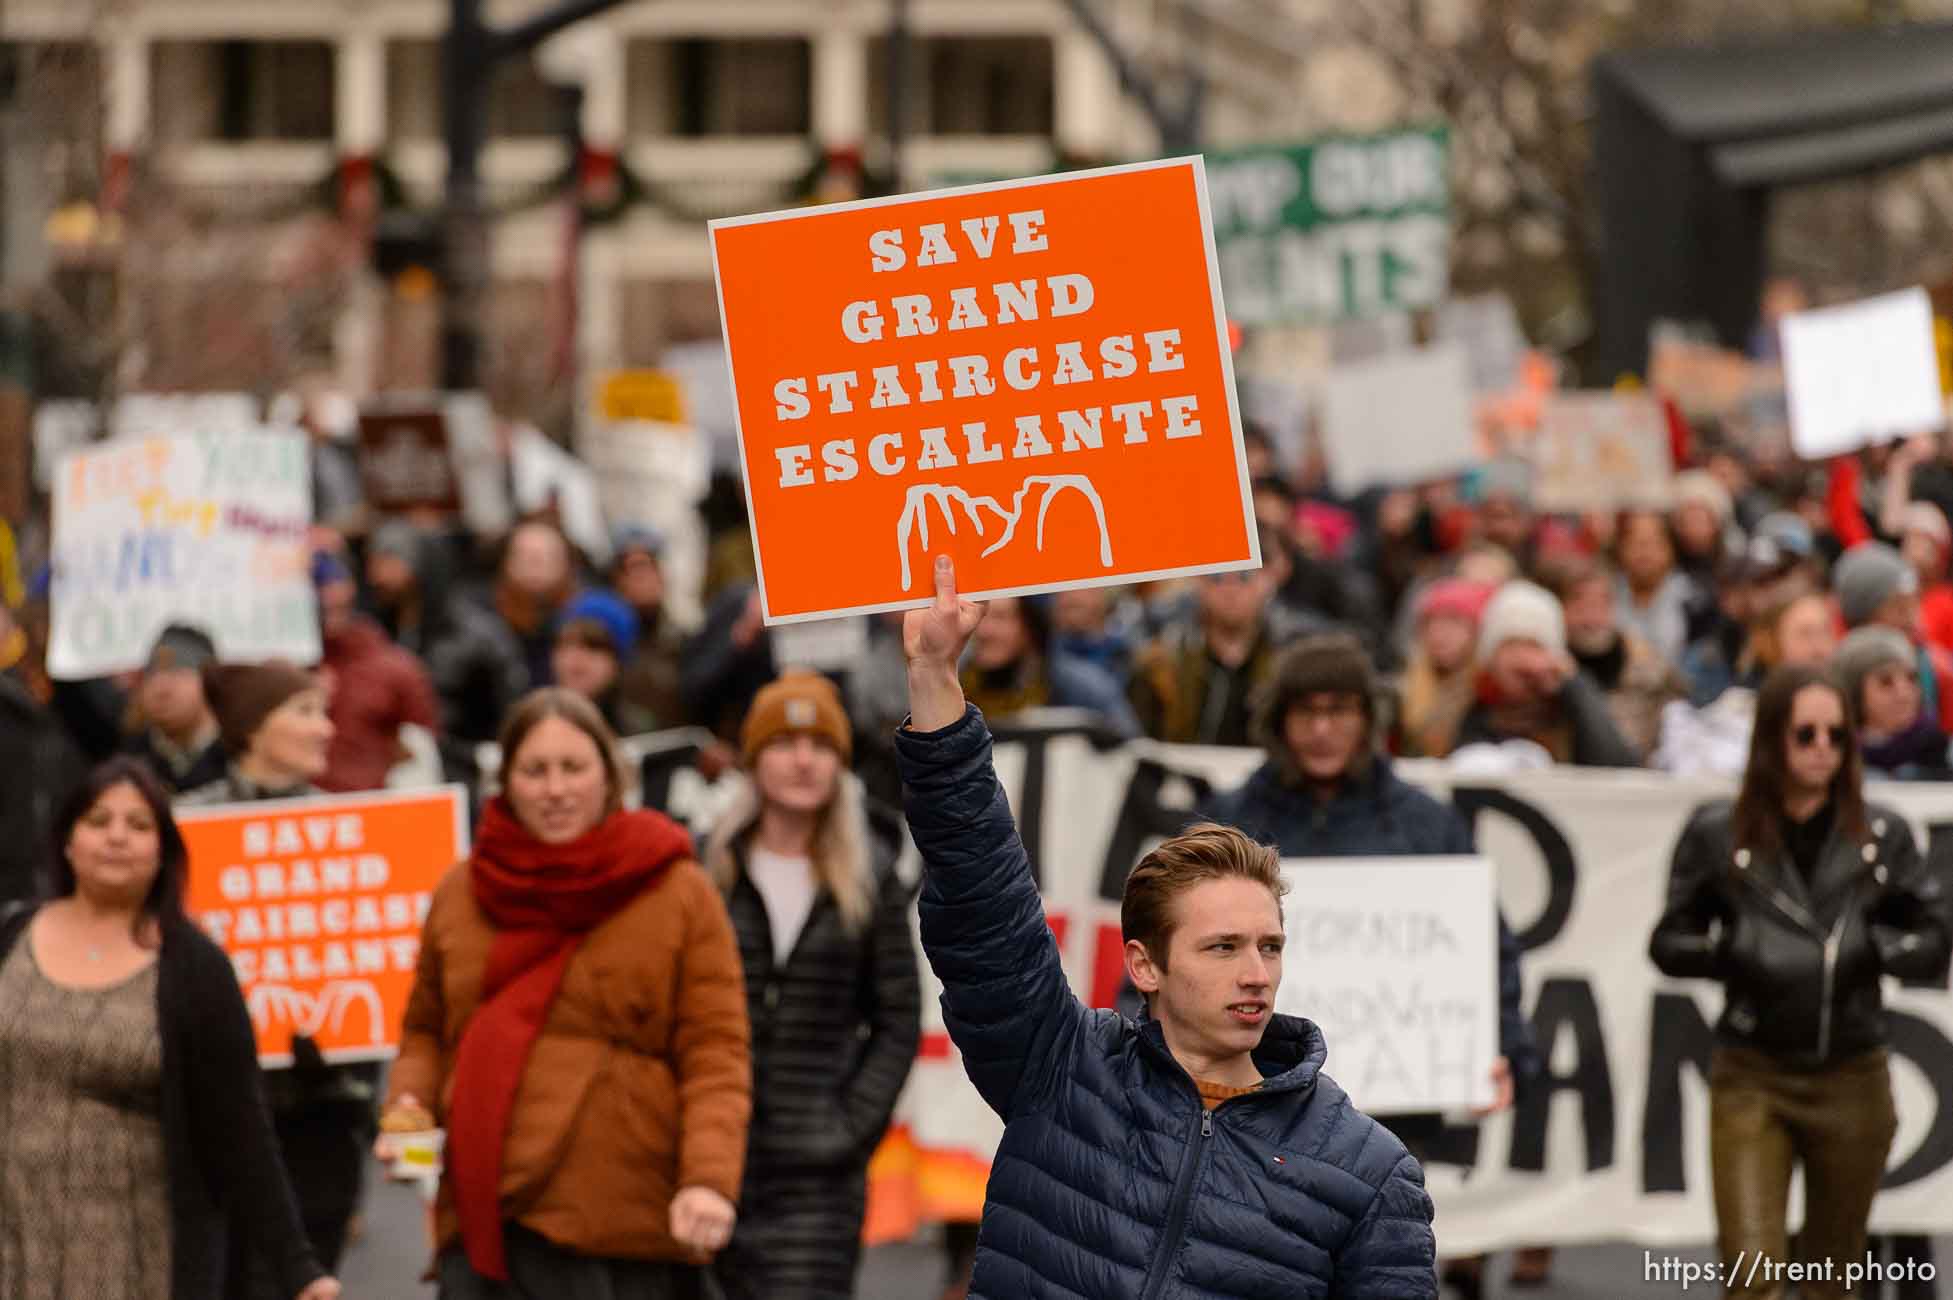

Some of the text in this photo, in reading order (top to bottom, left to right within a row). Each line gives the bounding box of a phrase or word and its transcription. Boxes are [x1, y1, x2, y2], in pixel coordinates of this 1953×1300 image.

[870, 210, 1048, 272] SAVE
[842, 274, 1094, 343] GRAND
[774, 329, 1184, 420] STAIRCASE
[775, 396, 1201, 488] ESCALANTE
[242, 813, 363, 858] SAVE
[219, 853, 390, 901] GRAND
